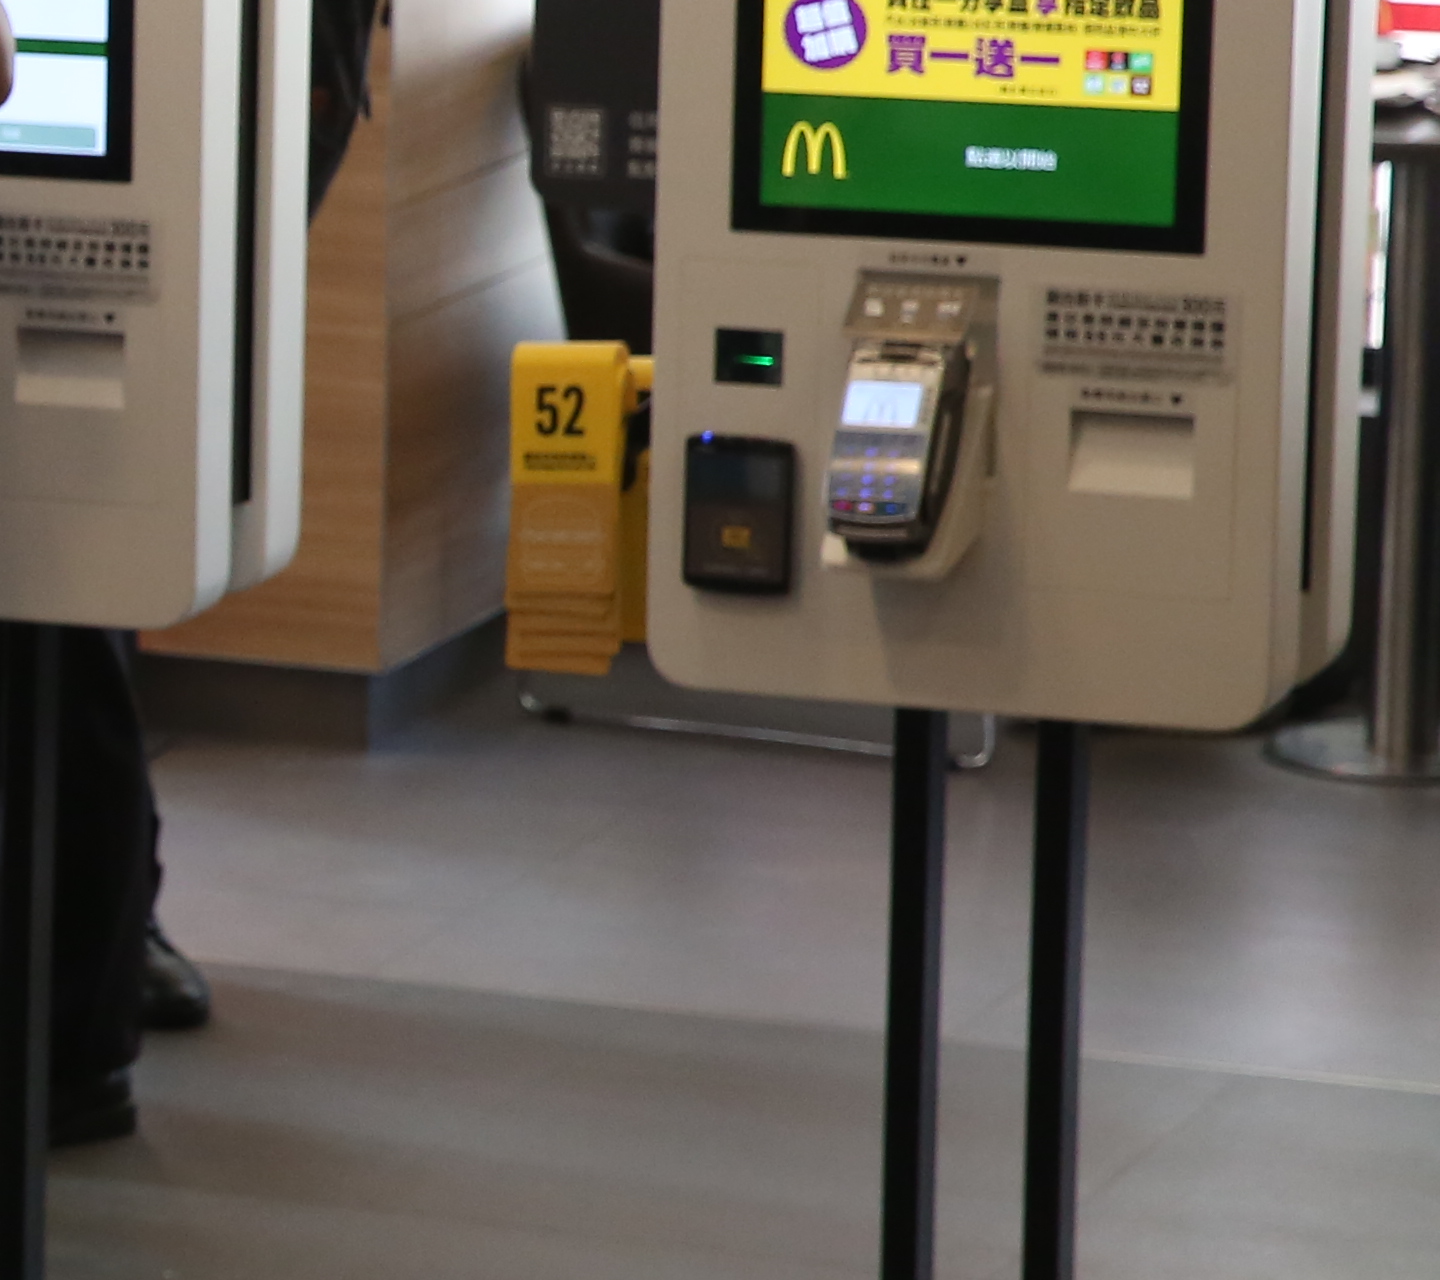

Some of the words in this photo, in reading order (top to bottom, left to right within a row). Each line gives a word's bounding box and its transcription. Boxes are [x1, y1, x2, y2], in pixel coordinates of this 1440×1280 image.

[886, 33, 1061, 78] 買一送一
[535, 385, 584, 436] 52
